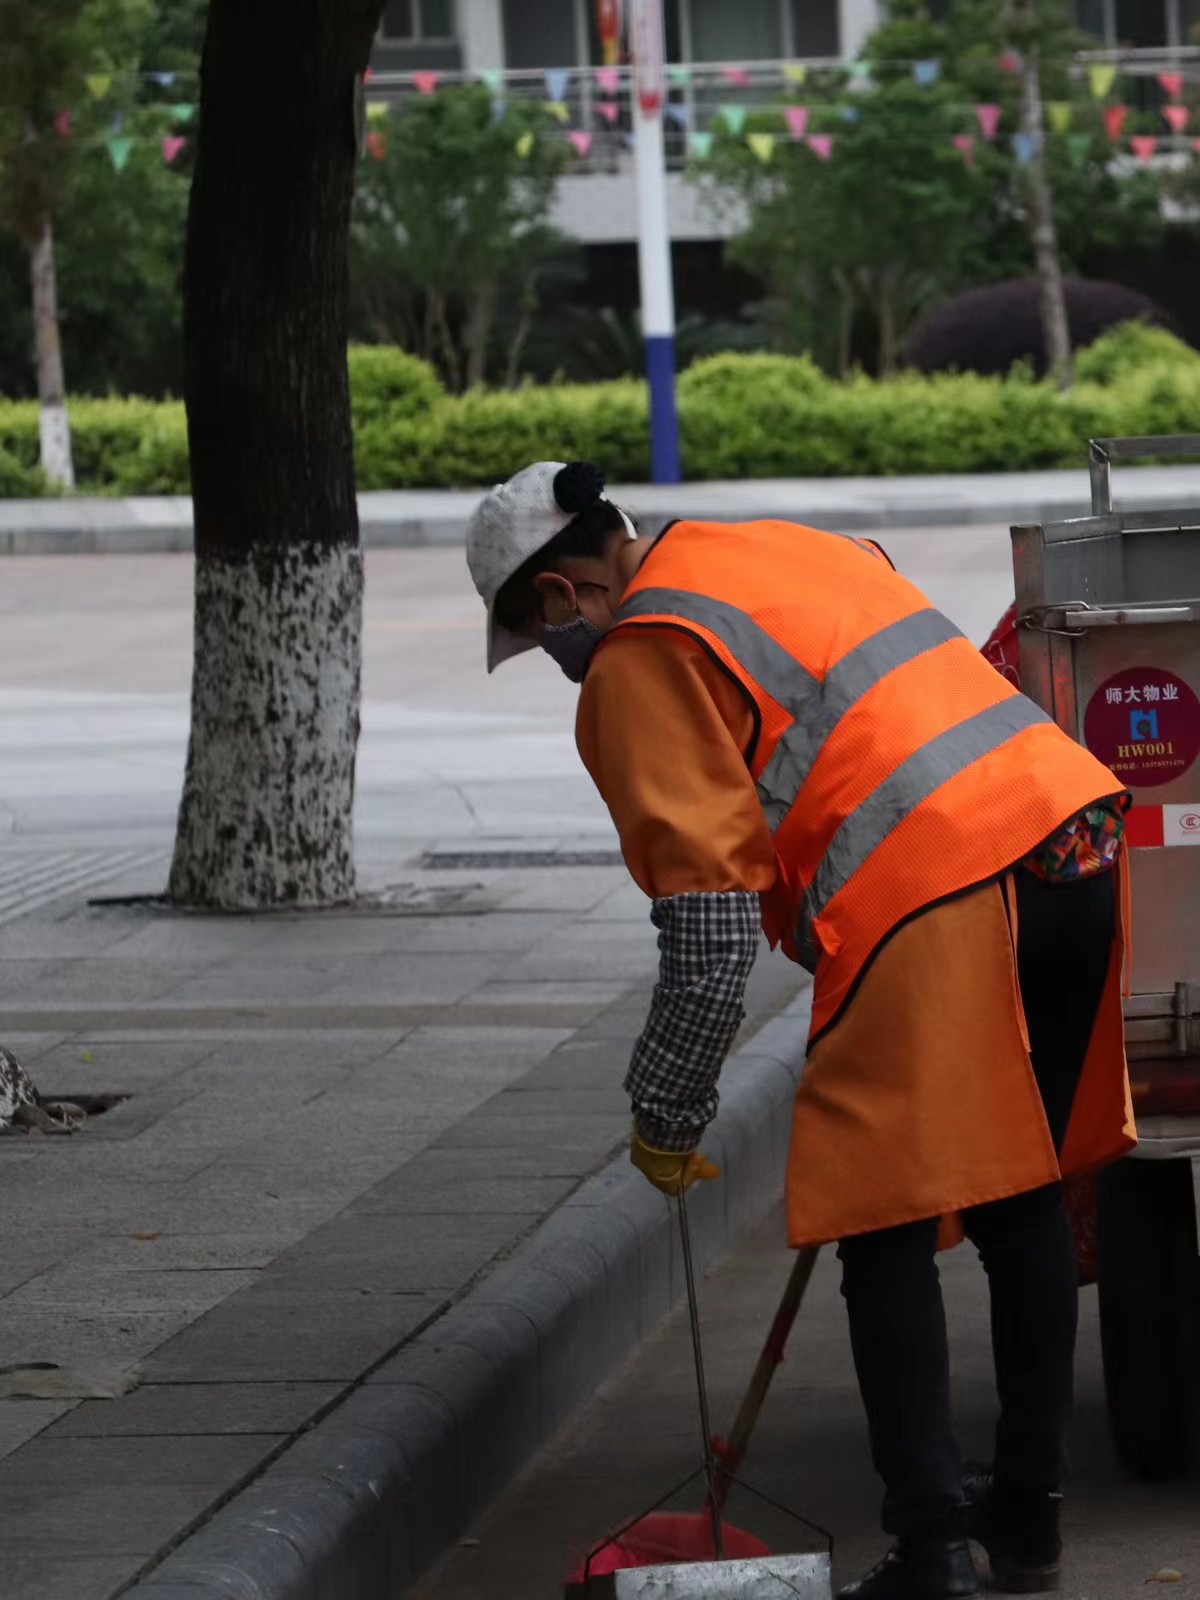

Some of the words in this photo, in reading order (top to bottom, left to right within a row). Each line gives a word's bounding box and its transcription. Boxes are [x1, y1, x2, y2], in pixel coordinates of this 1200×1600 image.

[1105, 683, 1179, 704] 师大物业
[1118, 742, 1174, 758] HW001
